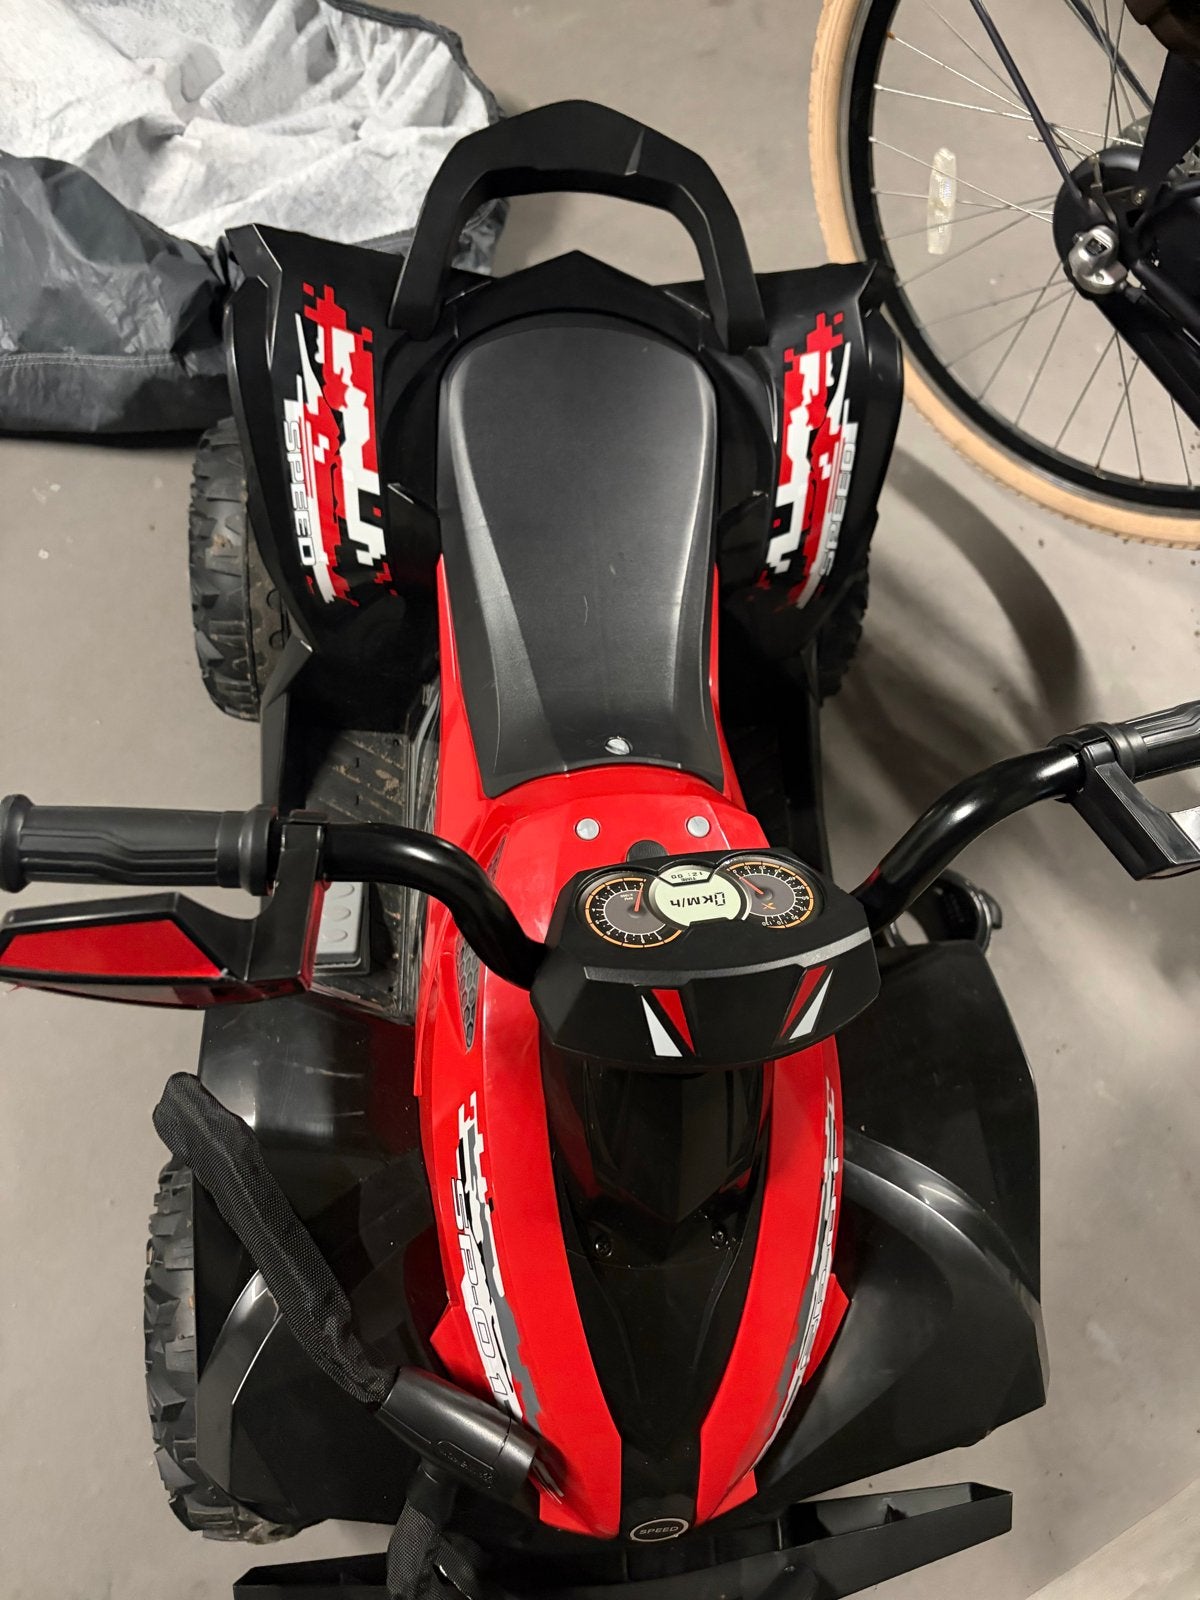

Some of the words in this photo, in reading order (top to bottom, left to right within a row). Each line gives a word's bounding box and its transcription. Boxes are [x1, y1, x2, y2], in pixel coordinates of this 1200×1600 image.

[284, 420, 317, 567] SPEED
[451, 1176, 509, 1396] SP-01
[639, 1525, 680, 1535] SPEED
